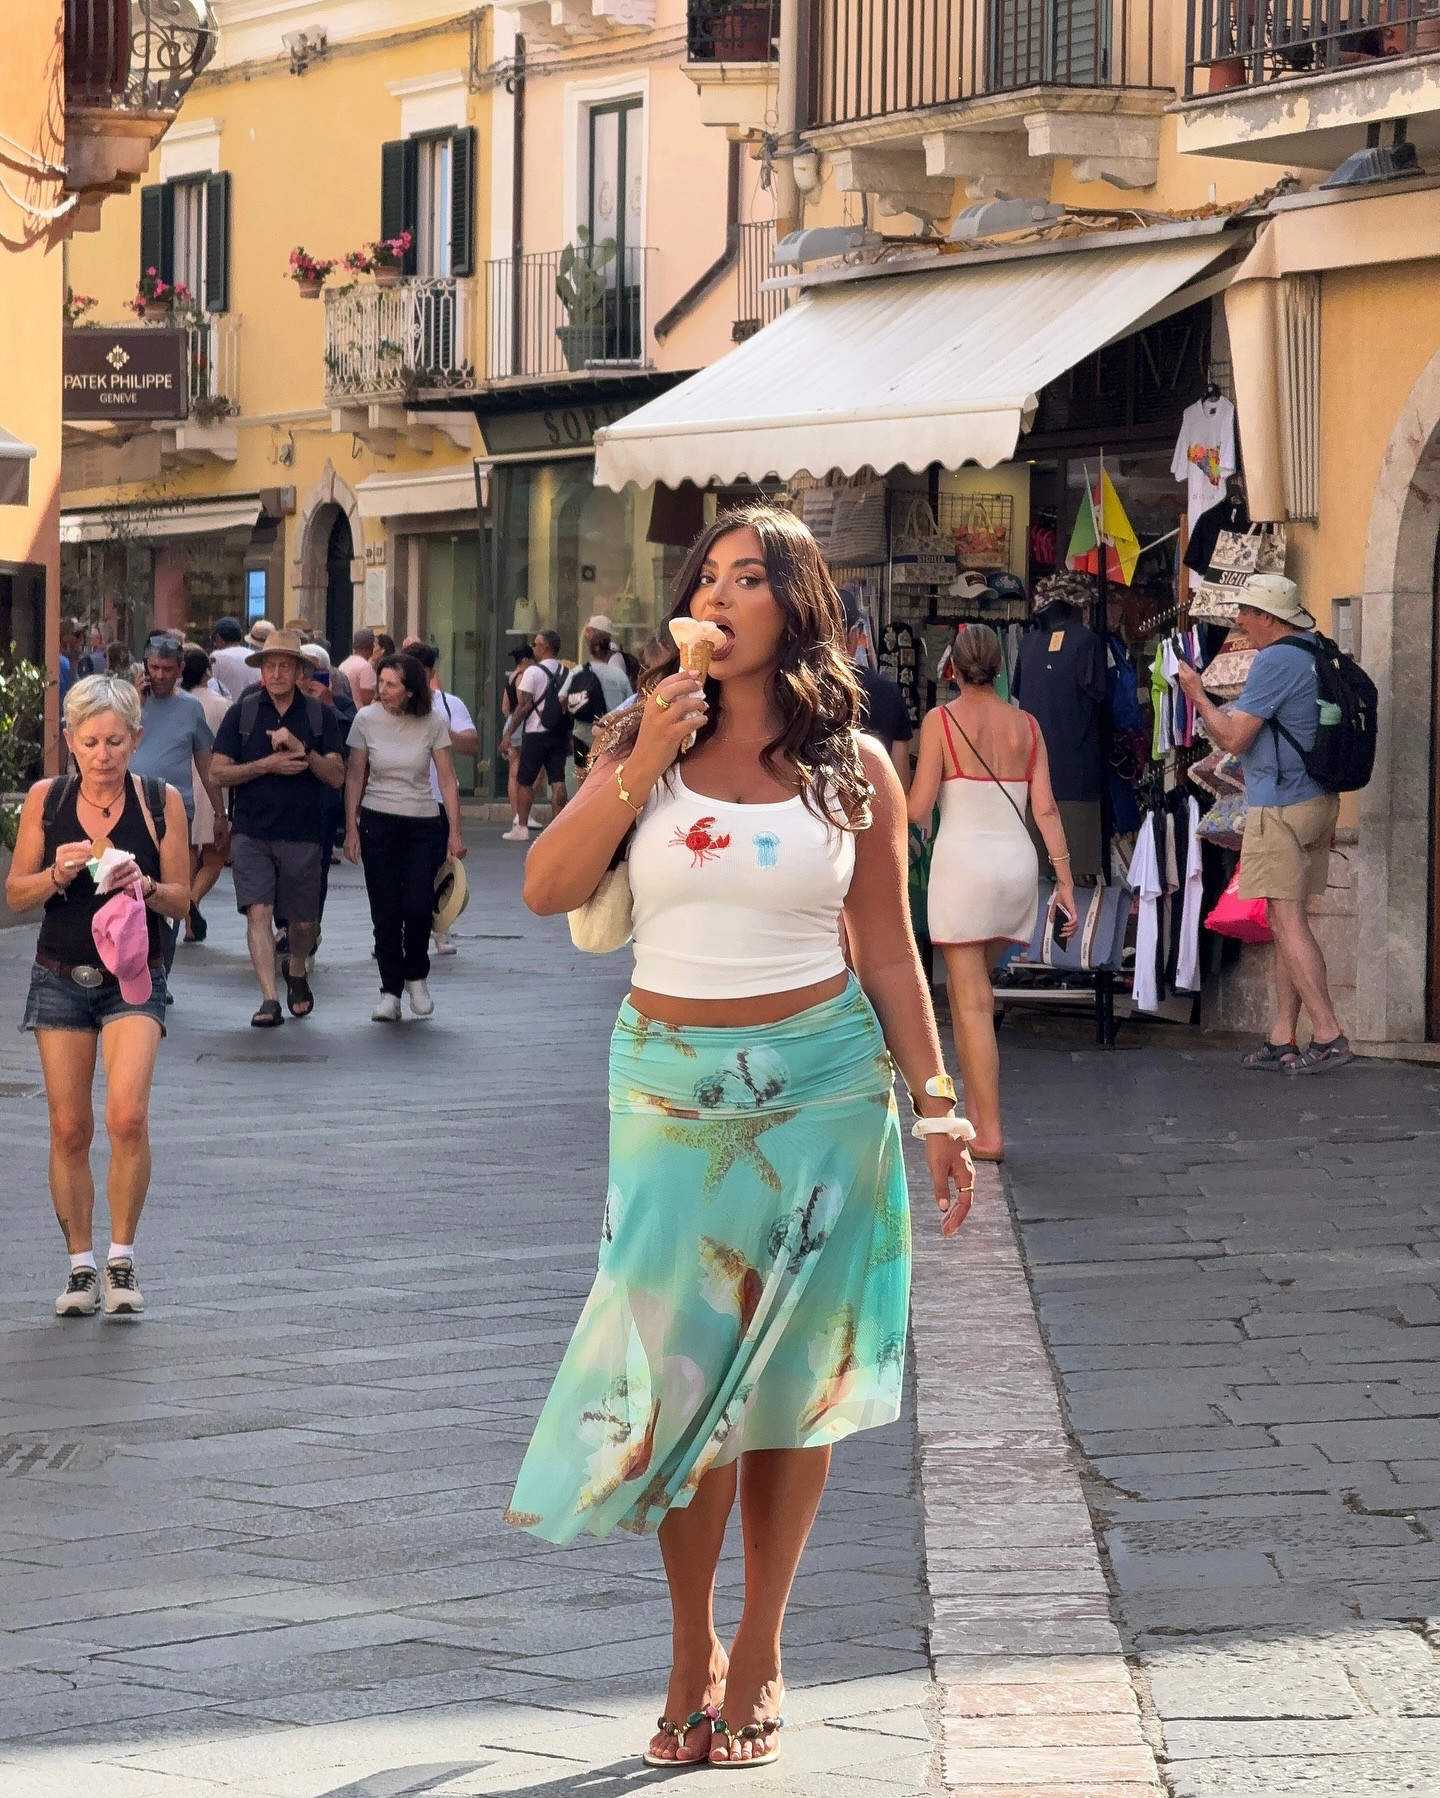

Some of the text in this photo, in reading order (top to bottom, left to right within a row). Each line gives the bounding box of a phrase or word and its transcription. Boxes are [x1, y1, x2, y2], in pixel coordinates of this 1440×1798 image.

[64, 374, 173, 389] PATEK PHILIPPE
[99, 392, 137, 404] GENEVE
[1219, 571, 1248, 586] SICIL
[568, 690, 589, 705] NIKE
